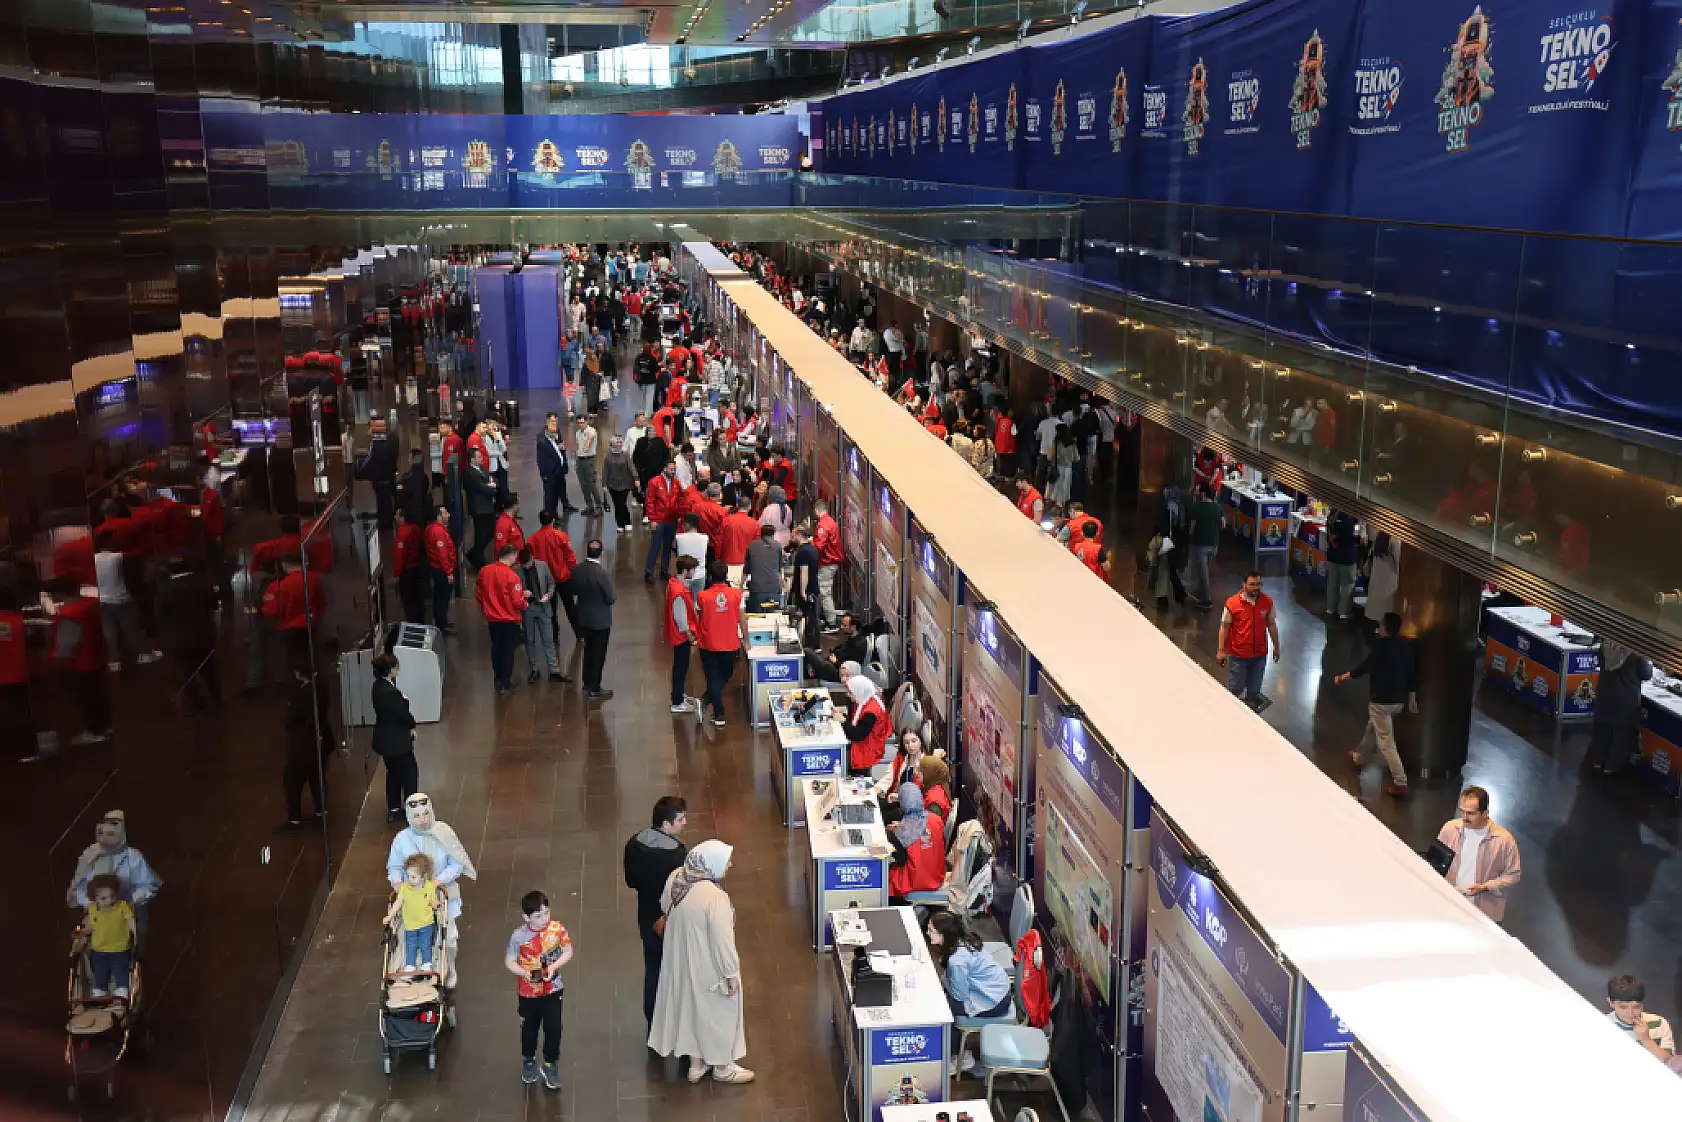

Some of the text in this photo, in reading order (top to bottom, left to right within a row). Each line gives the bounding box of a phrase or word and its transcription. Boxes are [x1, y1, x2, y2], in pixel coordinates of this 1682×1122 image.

[1540, 24, 1611, 63] TEKNO
[1355, 67, 1400, 93] TEKNO
[1543, 60, 1579, 92] SEL
[1229, 78, 1259, 102] TEKNO
[1230, 102, 1246, 121] SEL
[1358, 96, 1380, 119] SEL
[1437, 102, 1481, 133] TEKNO
[1446, 128, 1467, 151] SEL
[764, 664, 789, 673] TEKNO
[801, 755, 829, 764] TEKNO
[835, 866, 867, 876] TEKNO
[840, 875, 858, 883] SEL
[884, 1034, 926, 1047] TEKNO
[891, 1046, 913, 1056] SEL
